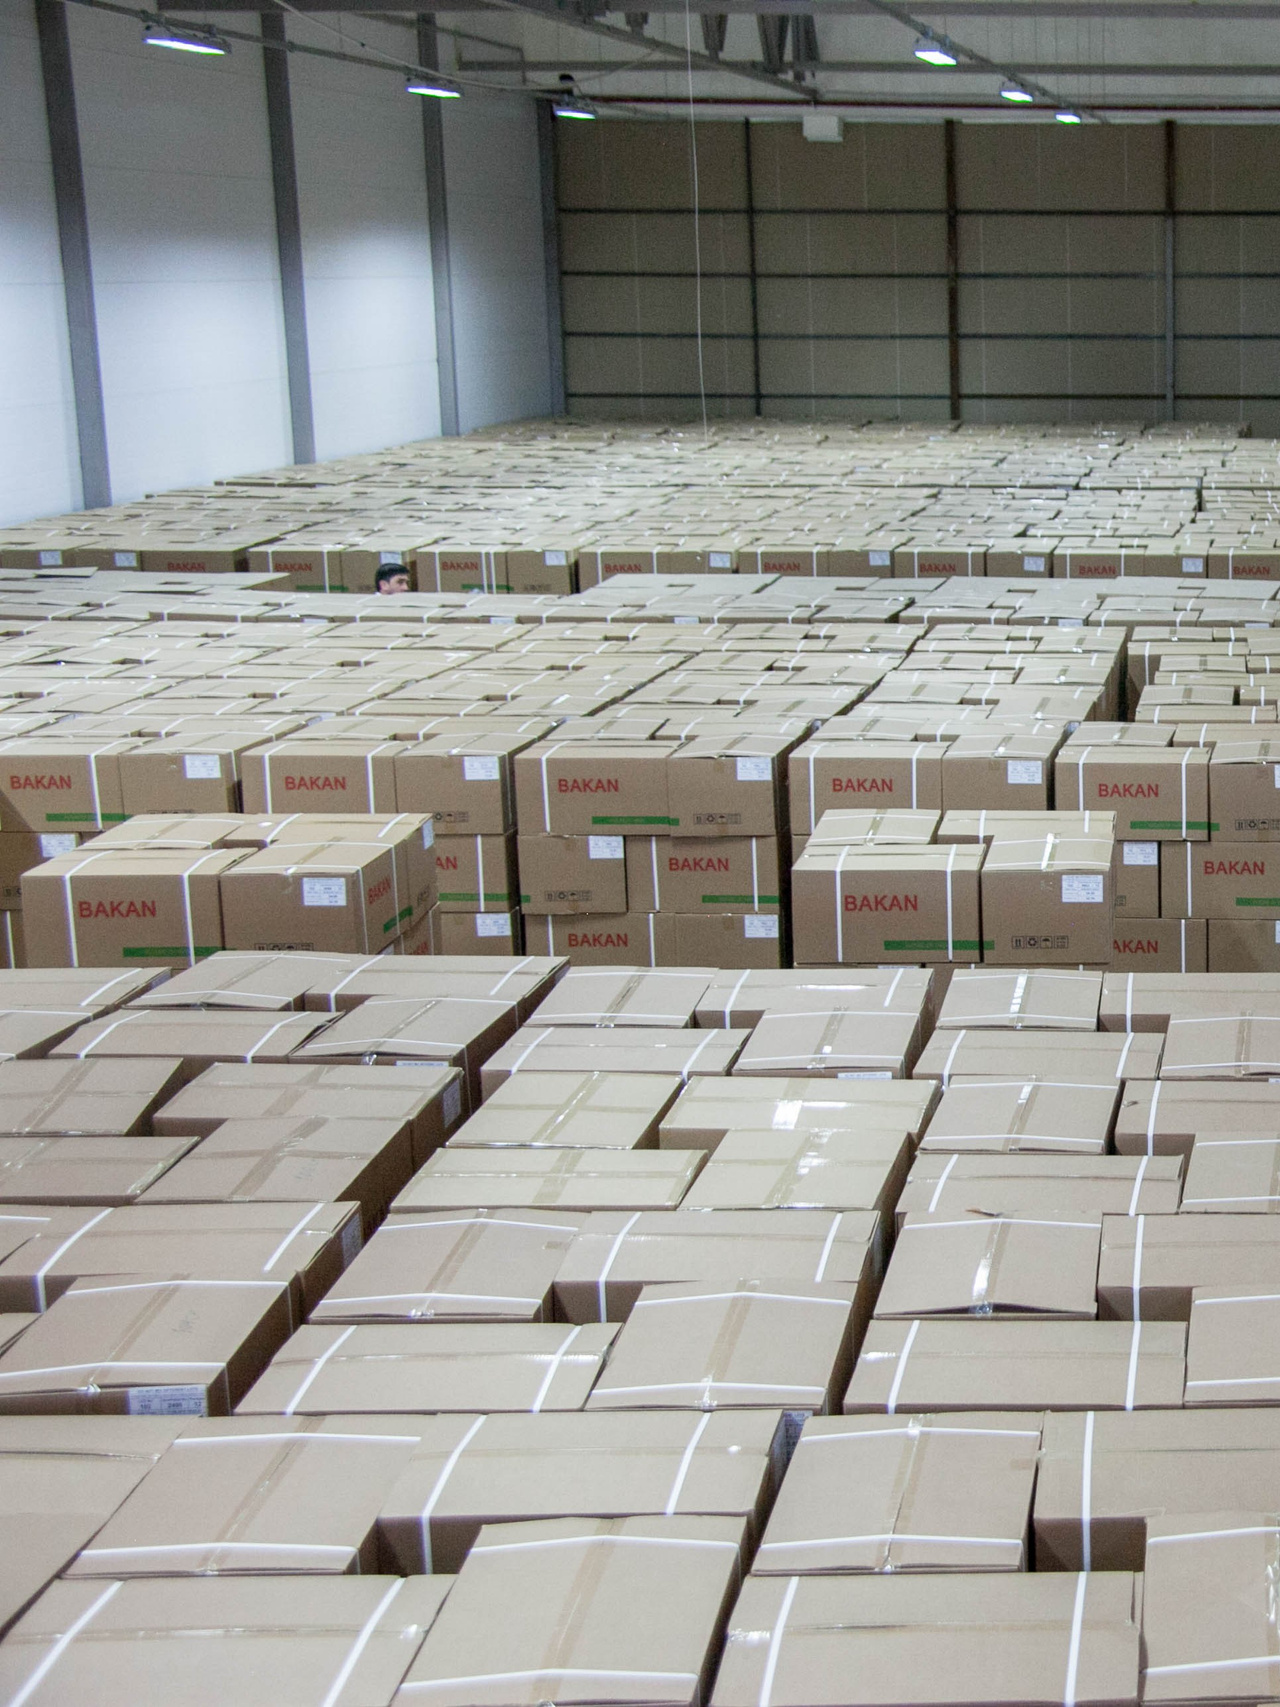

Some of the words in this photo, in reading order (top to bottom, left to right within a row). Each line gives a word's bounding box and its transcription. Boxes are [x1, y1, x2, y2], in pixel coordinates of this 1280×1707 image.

[168, 563, 205, 572] BAKAN
[275, 563, 312, 572] BAKAN
[442, 562, 478, 570] BAKAN
[604, 564, 641, 573] BAKAN
[764, 563, 800, 571] BAKAN
[920, 564, 956, 573] BAKAN
[1079, 566, 1116, 576] BAKAN
[1232, 566, 1270, 576] BAKAN
[10, 776, 71, 790] BAKAN
[285, 776, 346, 790] BAKAN
[558, 779, 619, 793] BAKAN
[832, 778, 893, 792] BAKAN
[1098, 783, 1158, 797] BAKAN
[669, 858, 729, 871] BAKAN
[1204, 861, 1265, 875] BAKAN
[79, 902, 156, 918] BAKAN
[845, 895, 918, 912] BAKAN
[568, 934, 628, 947] BAKAN
[1113, 939, 1158, 953] AKAN
